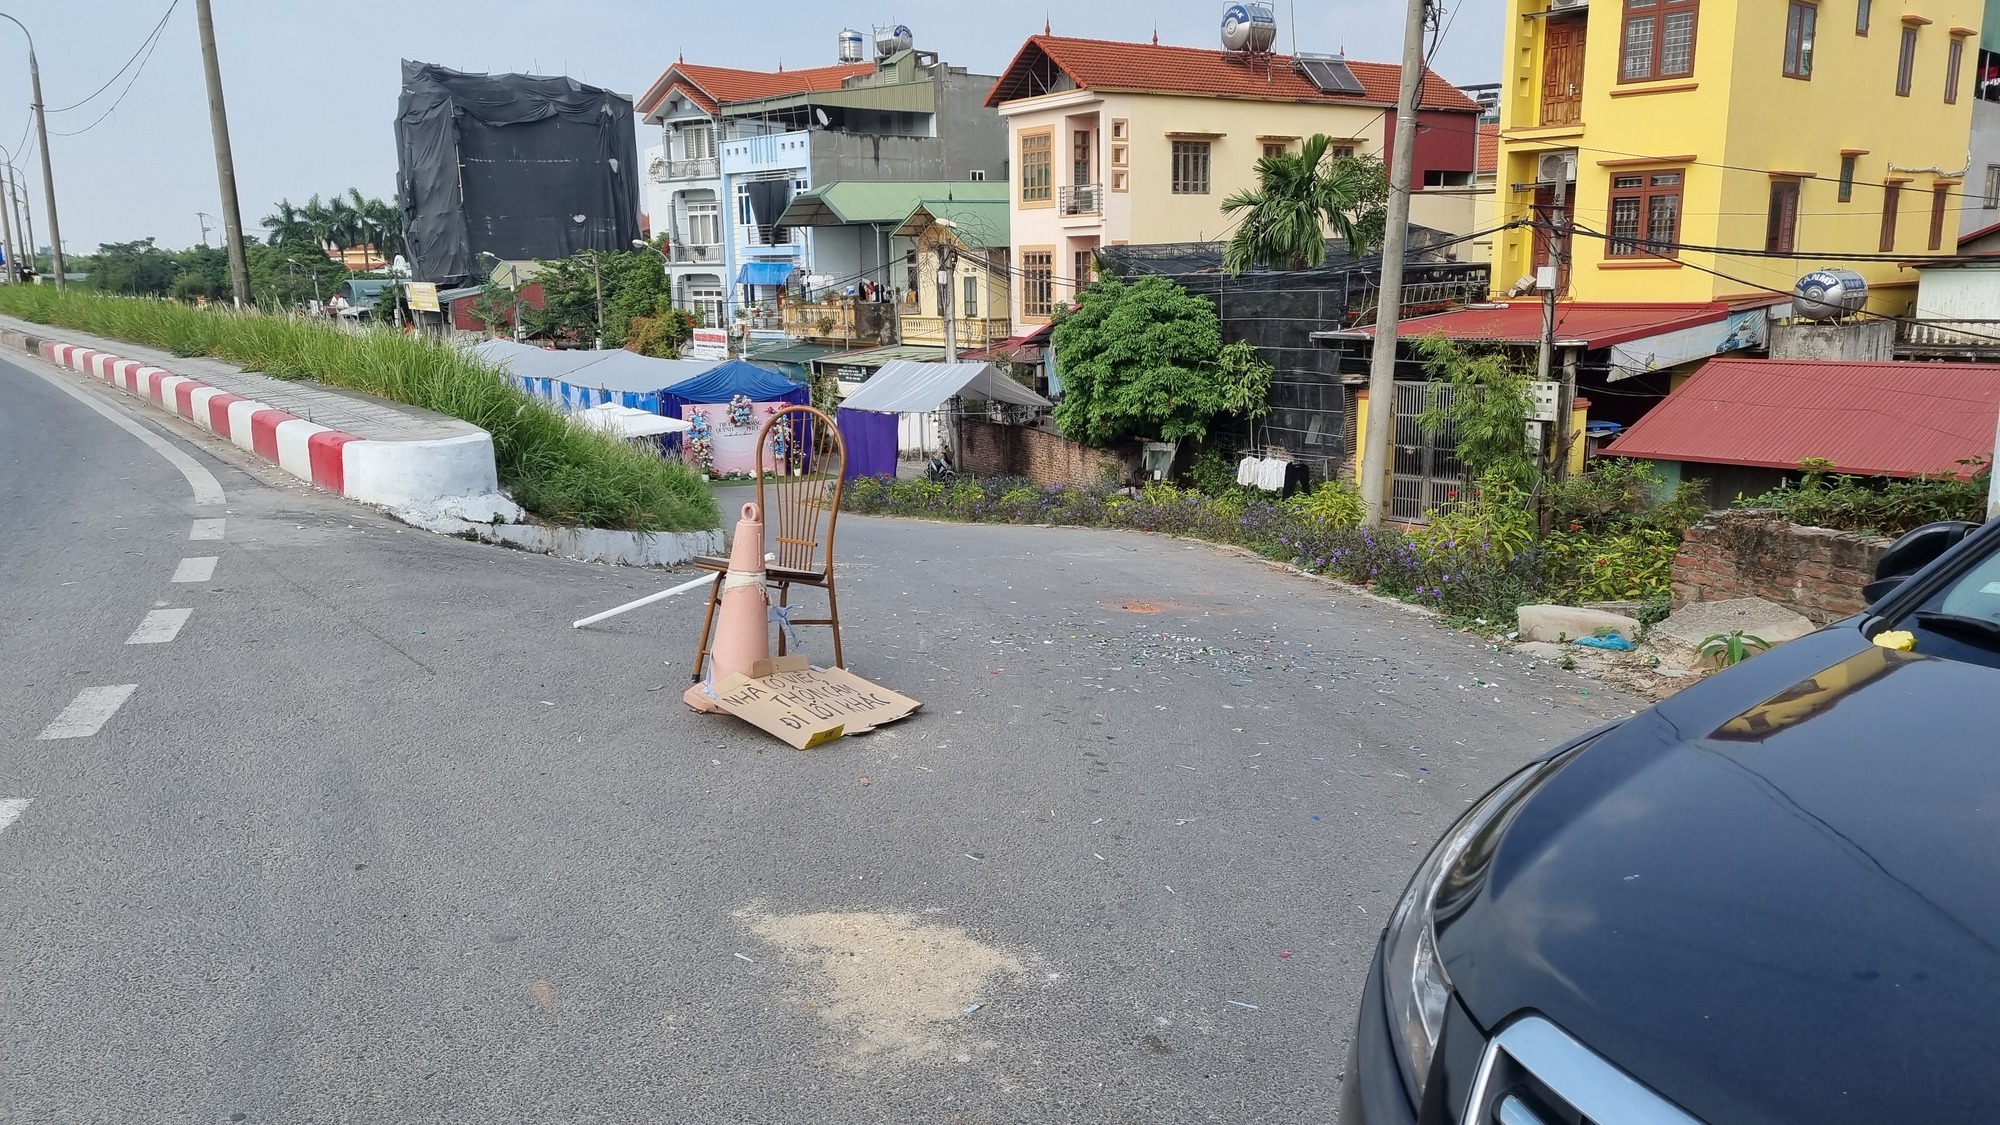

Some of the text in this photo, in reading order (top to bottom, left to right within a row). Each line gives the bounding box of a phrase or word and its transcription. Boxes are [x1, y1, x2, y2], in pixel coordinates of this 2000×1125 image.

[722, 670, 821, 706] NHÀ CÓ VIỆC
[778, 711, 810, 729] ĐI
[834, 693, 891, 713] KHÁC
